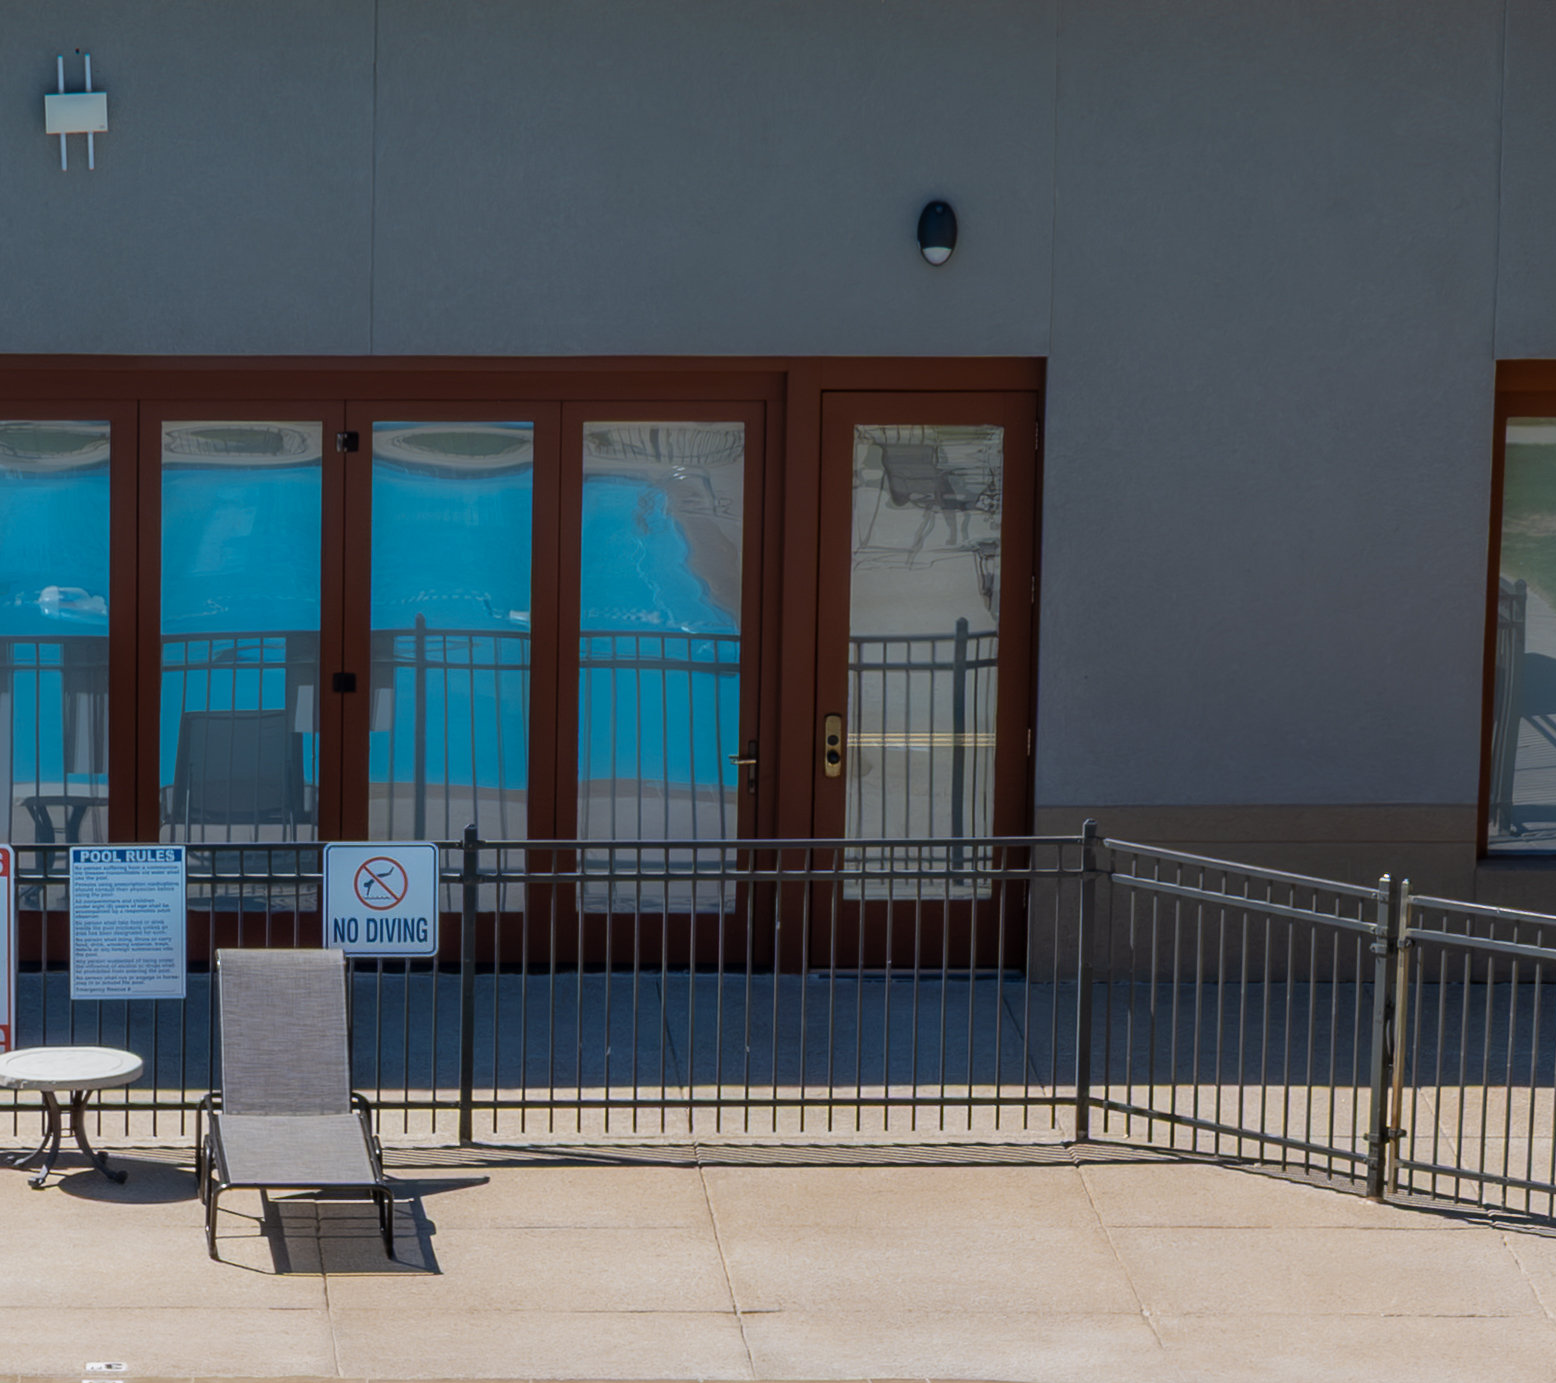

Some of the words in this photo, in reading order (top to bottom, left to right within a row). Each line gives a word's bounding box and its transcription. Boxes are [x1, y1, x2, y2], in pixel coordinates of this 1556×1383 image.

[80, 850, 121, 862] POOL
[125, 849, 176, 862] RULES
[334, 917, 359, 943] NO
[366, 917, 428, 943] DIVING
